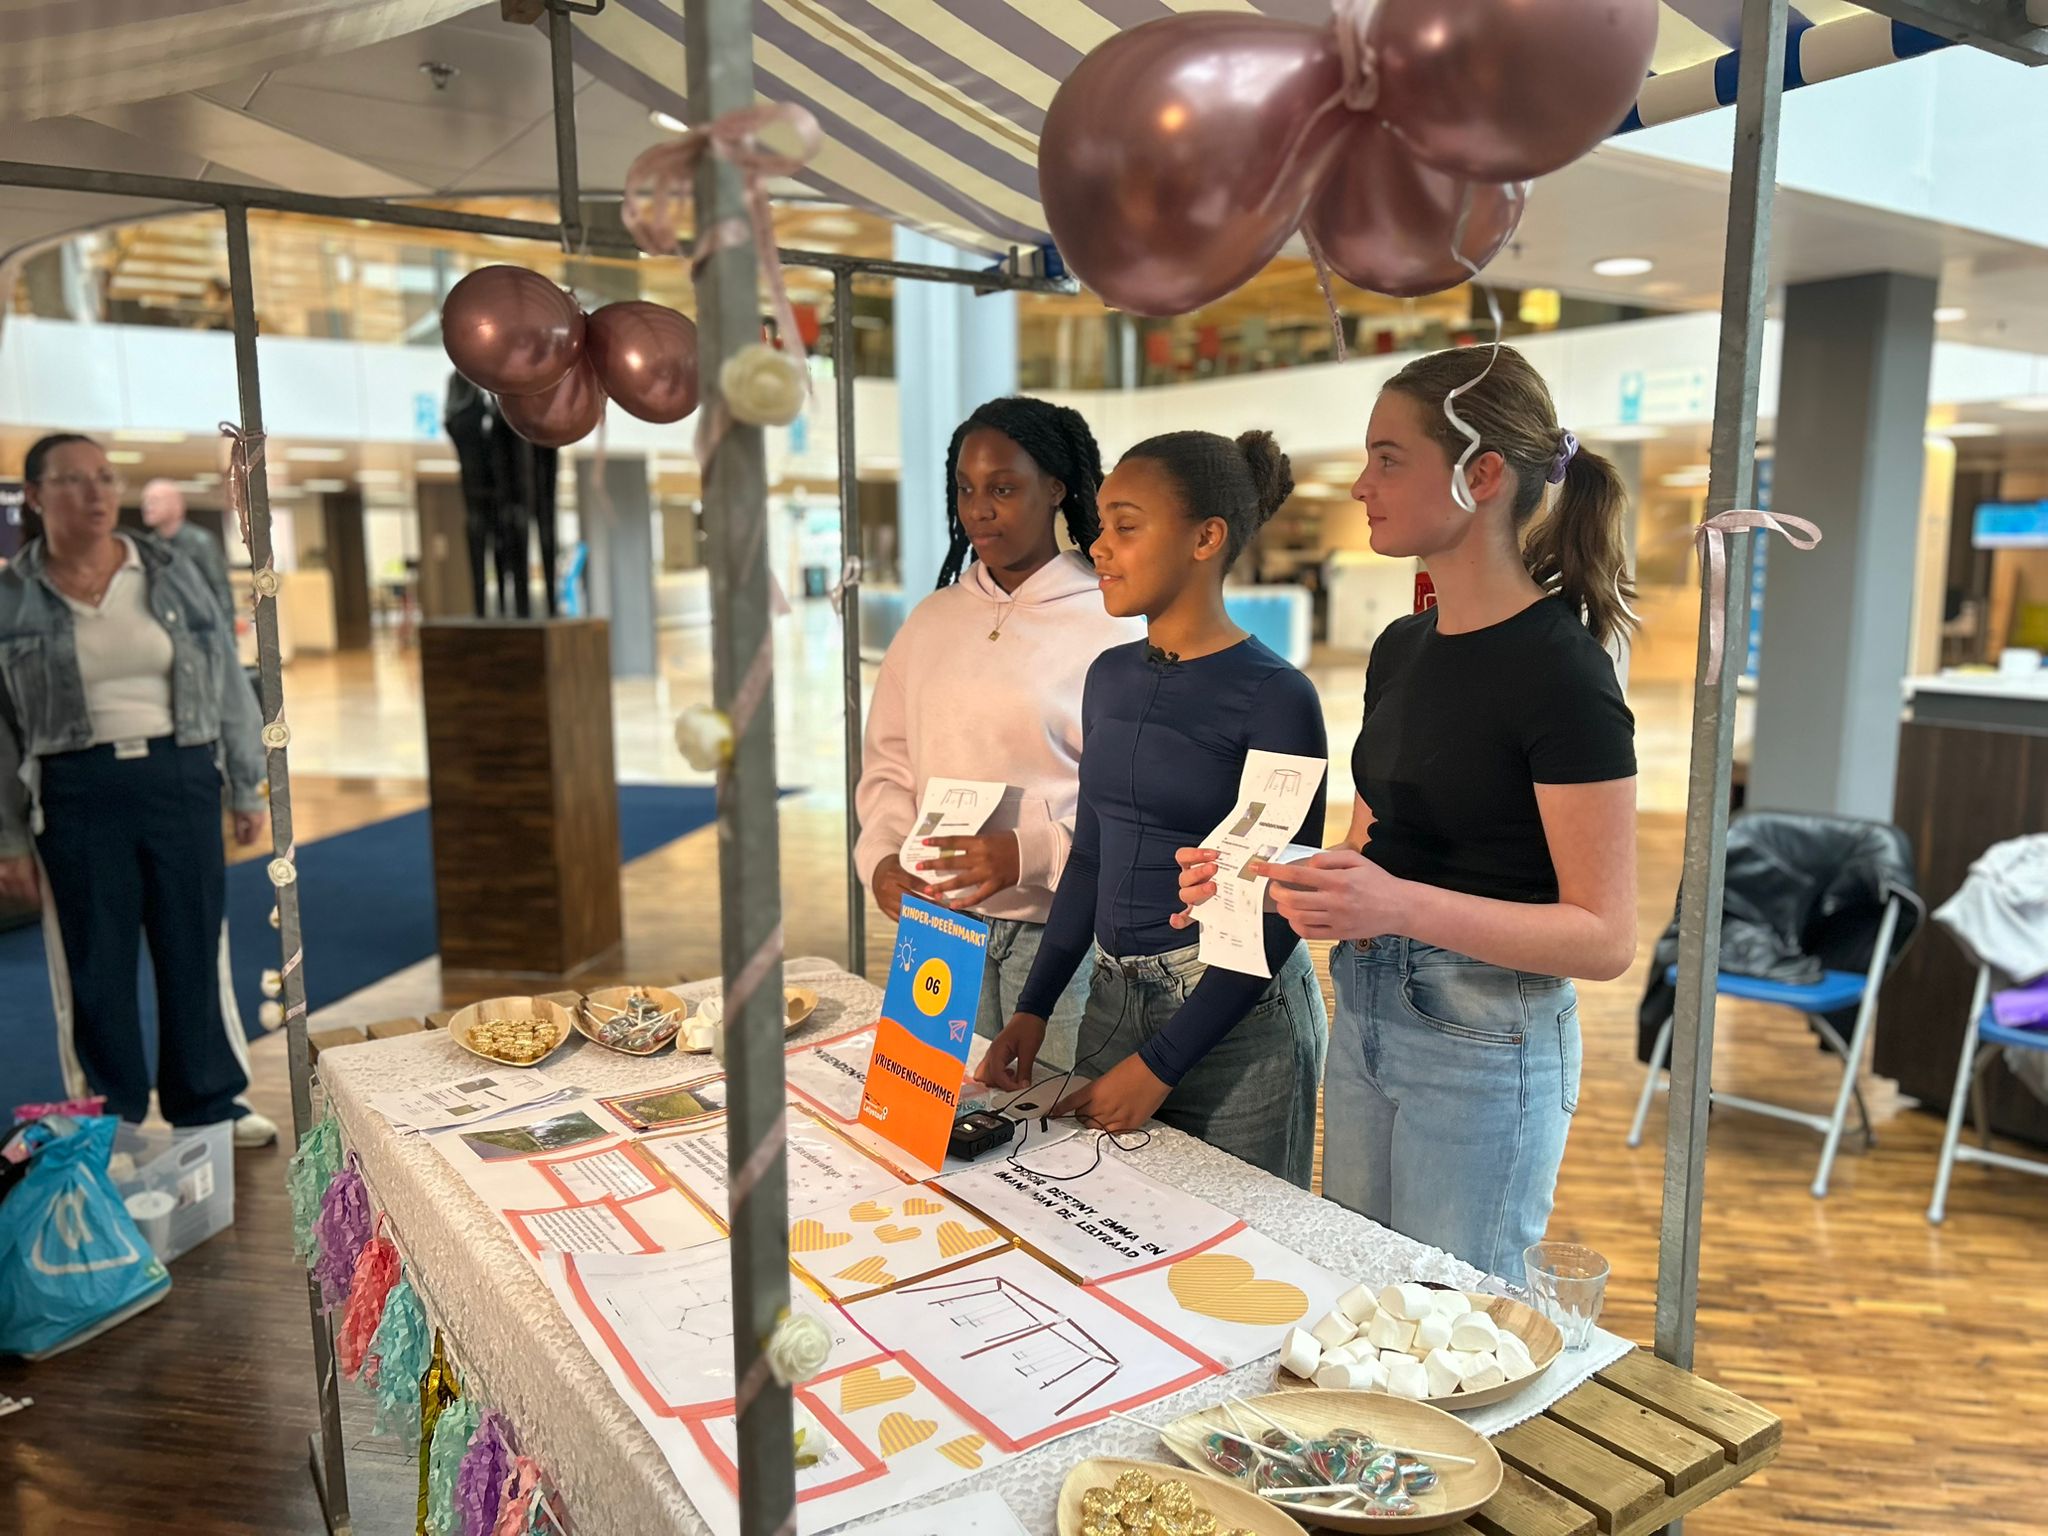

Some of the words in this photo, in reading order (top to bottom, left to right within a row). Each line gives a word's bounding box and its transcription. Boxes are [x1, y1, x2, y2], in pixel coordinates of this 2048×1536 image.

[902, 904, 987, 948] KINDER-IDEEËNMARKT
[925, 976, 941, 996] 06
[875, 1052, 956, 1108] VRIENDENSCHOMMEL
[993, 1171, 1029, 1193] IMANI
[1033, 1192, 1055, 1208] VAN
[1056, 1208, 1077, 1221] DE
[1076, 1220, 1141, 1260] LELYRAAD
[1011, 1165, 1047, 1187] DOOR
[1099, 1217, 1141, 1244] EMMA
[1141, 1242, 1168, 1256] EN
